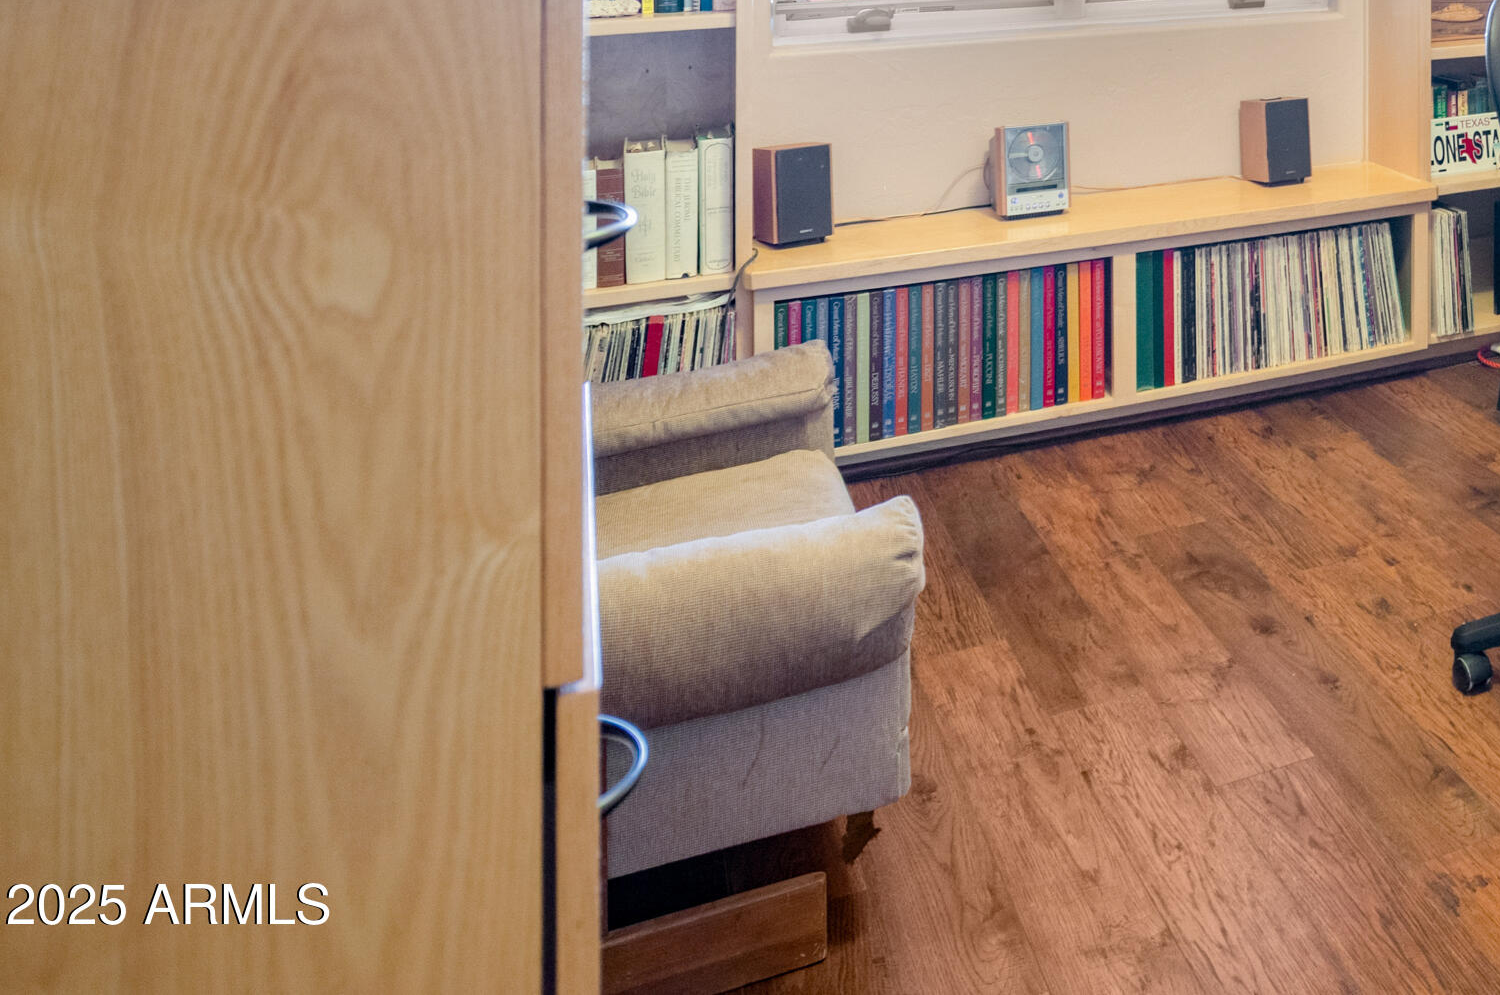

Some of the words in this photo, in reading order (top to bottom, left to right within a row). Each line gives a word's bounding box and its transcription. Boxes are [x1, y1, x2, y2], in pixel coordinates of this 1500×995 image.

[1460, 117, 1490, 128] TEXAS
[1431, 133, 1467, 166] ONE
[871, 372, 879, 405] DEBUSSY
